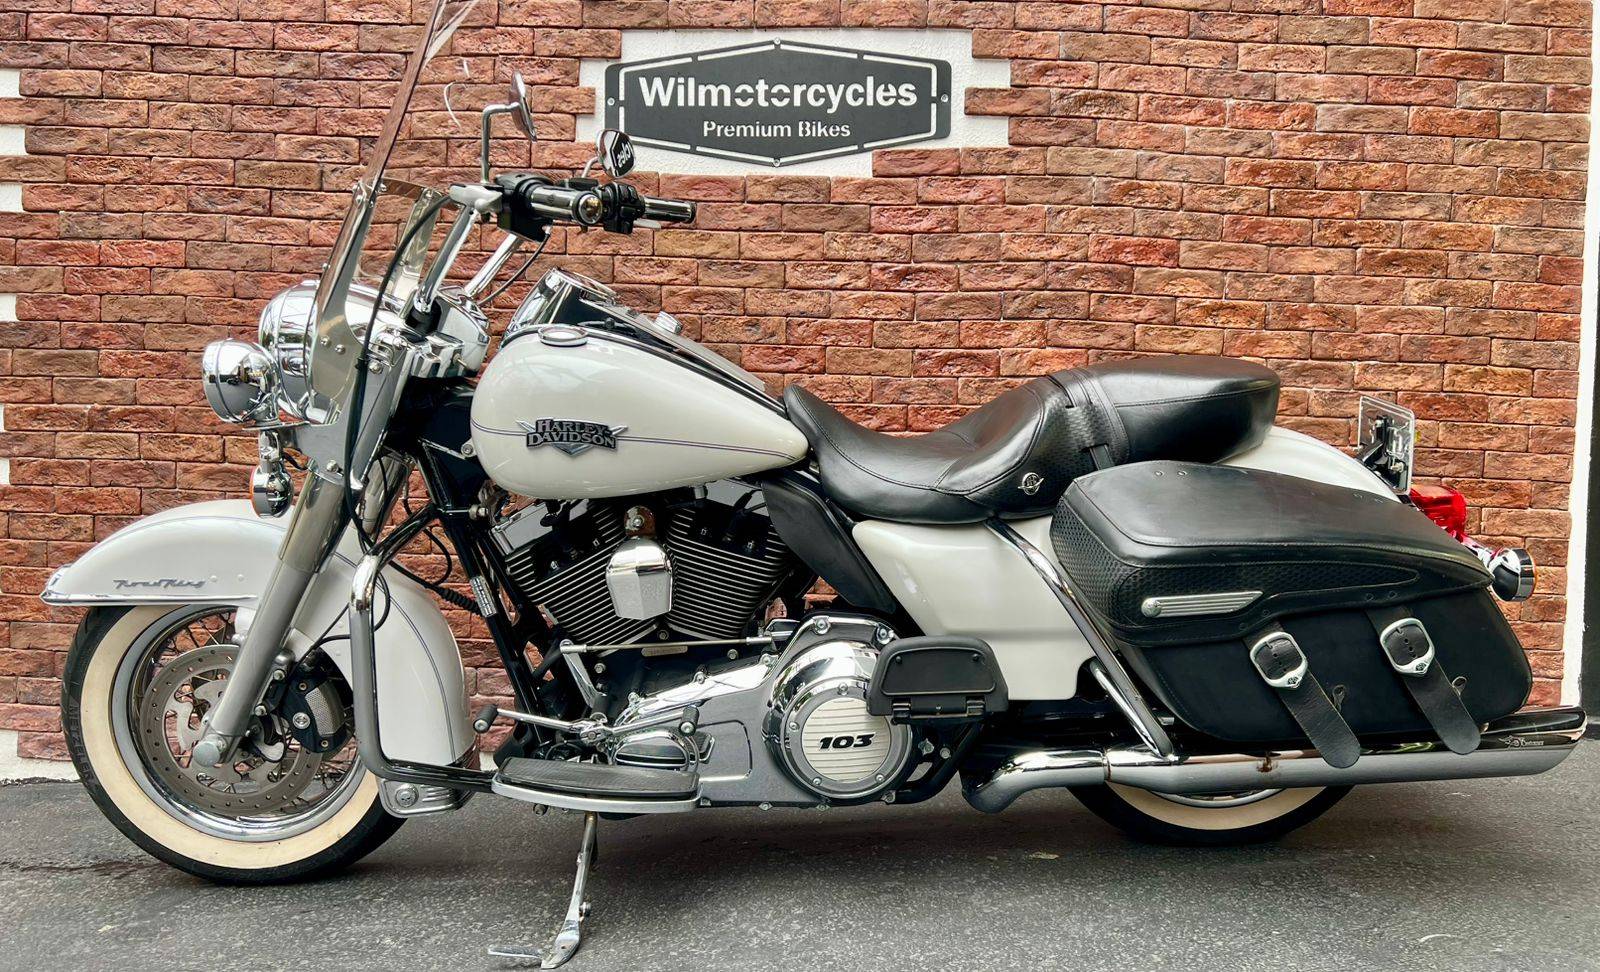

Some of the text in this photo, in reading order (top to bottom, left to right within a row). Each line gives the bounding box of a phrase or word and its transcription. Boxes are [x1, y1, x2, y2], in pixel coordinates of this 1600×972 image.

[638, 75, 918, 114] Wilmotorcycles
[703, 120, 851, 138] Premium Bikes
[536, 419, 610, 435] HARLEY-
[527, 431, 617, 448] DAVIDSON
[819, 732, 876, 750] 103
